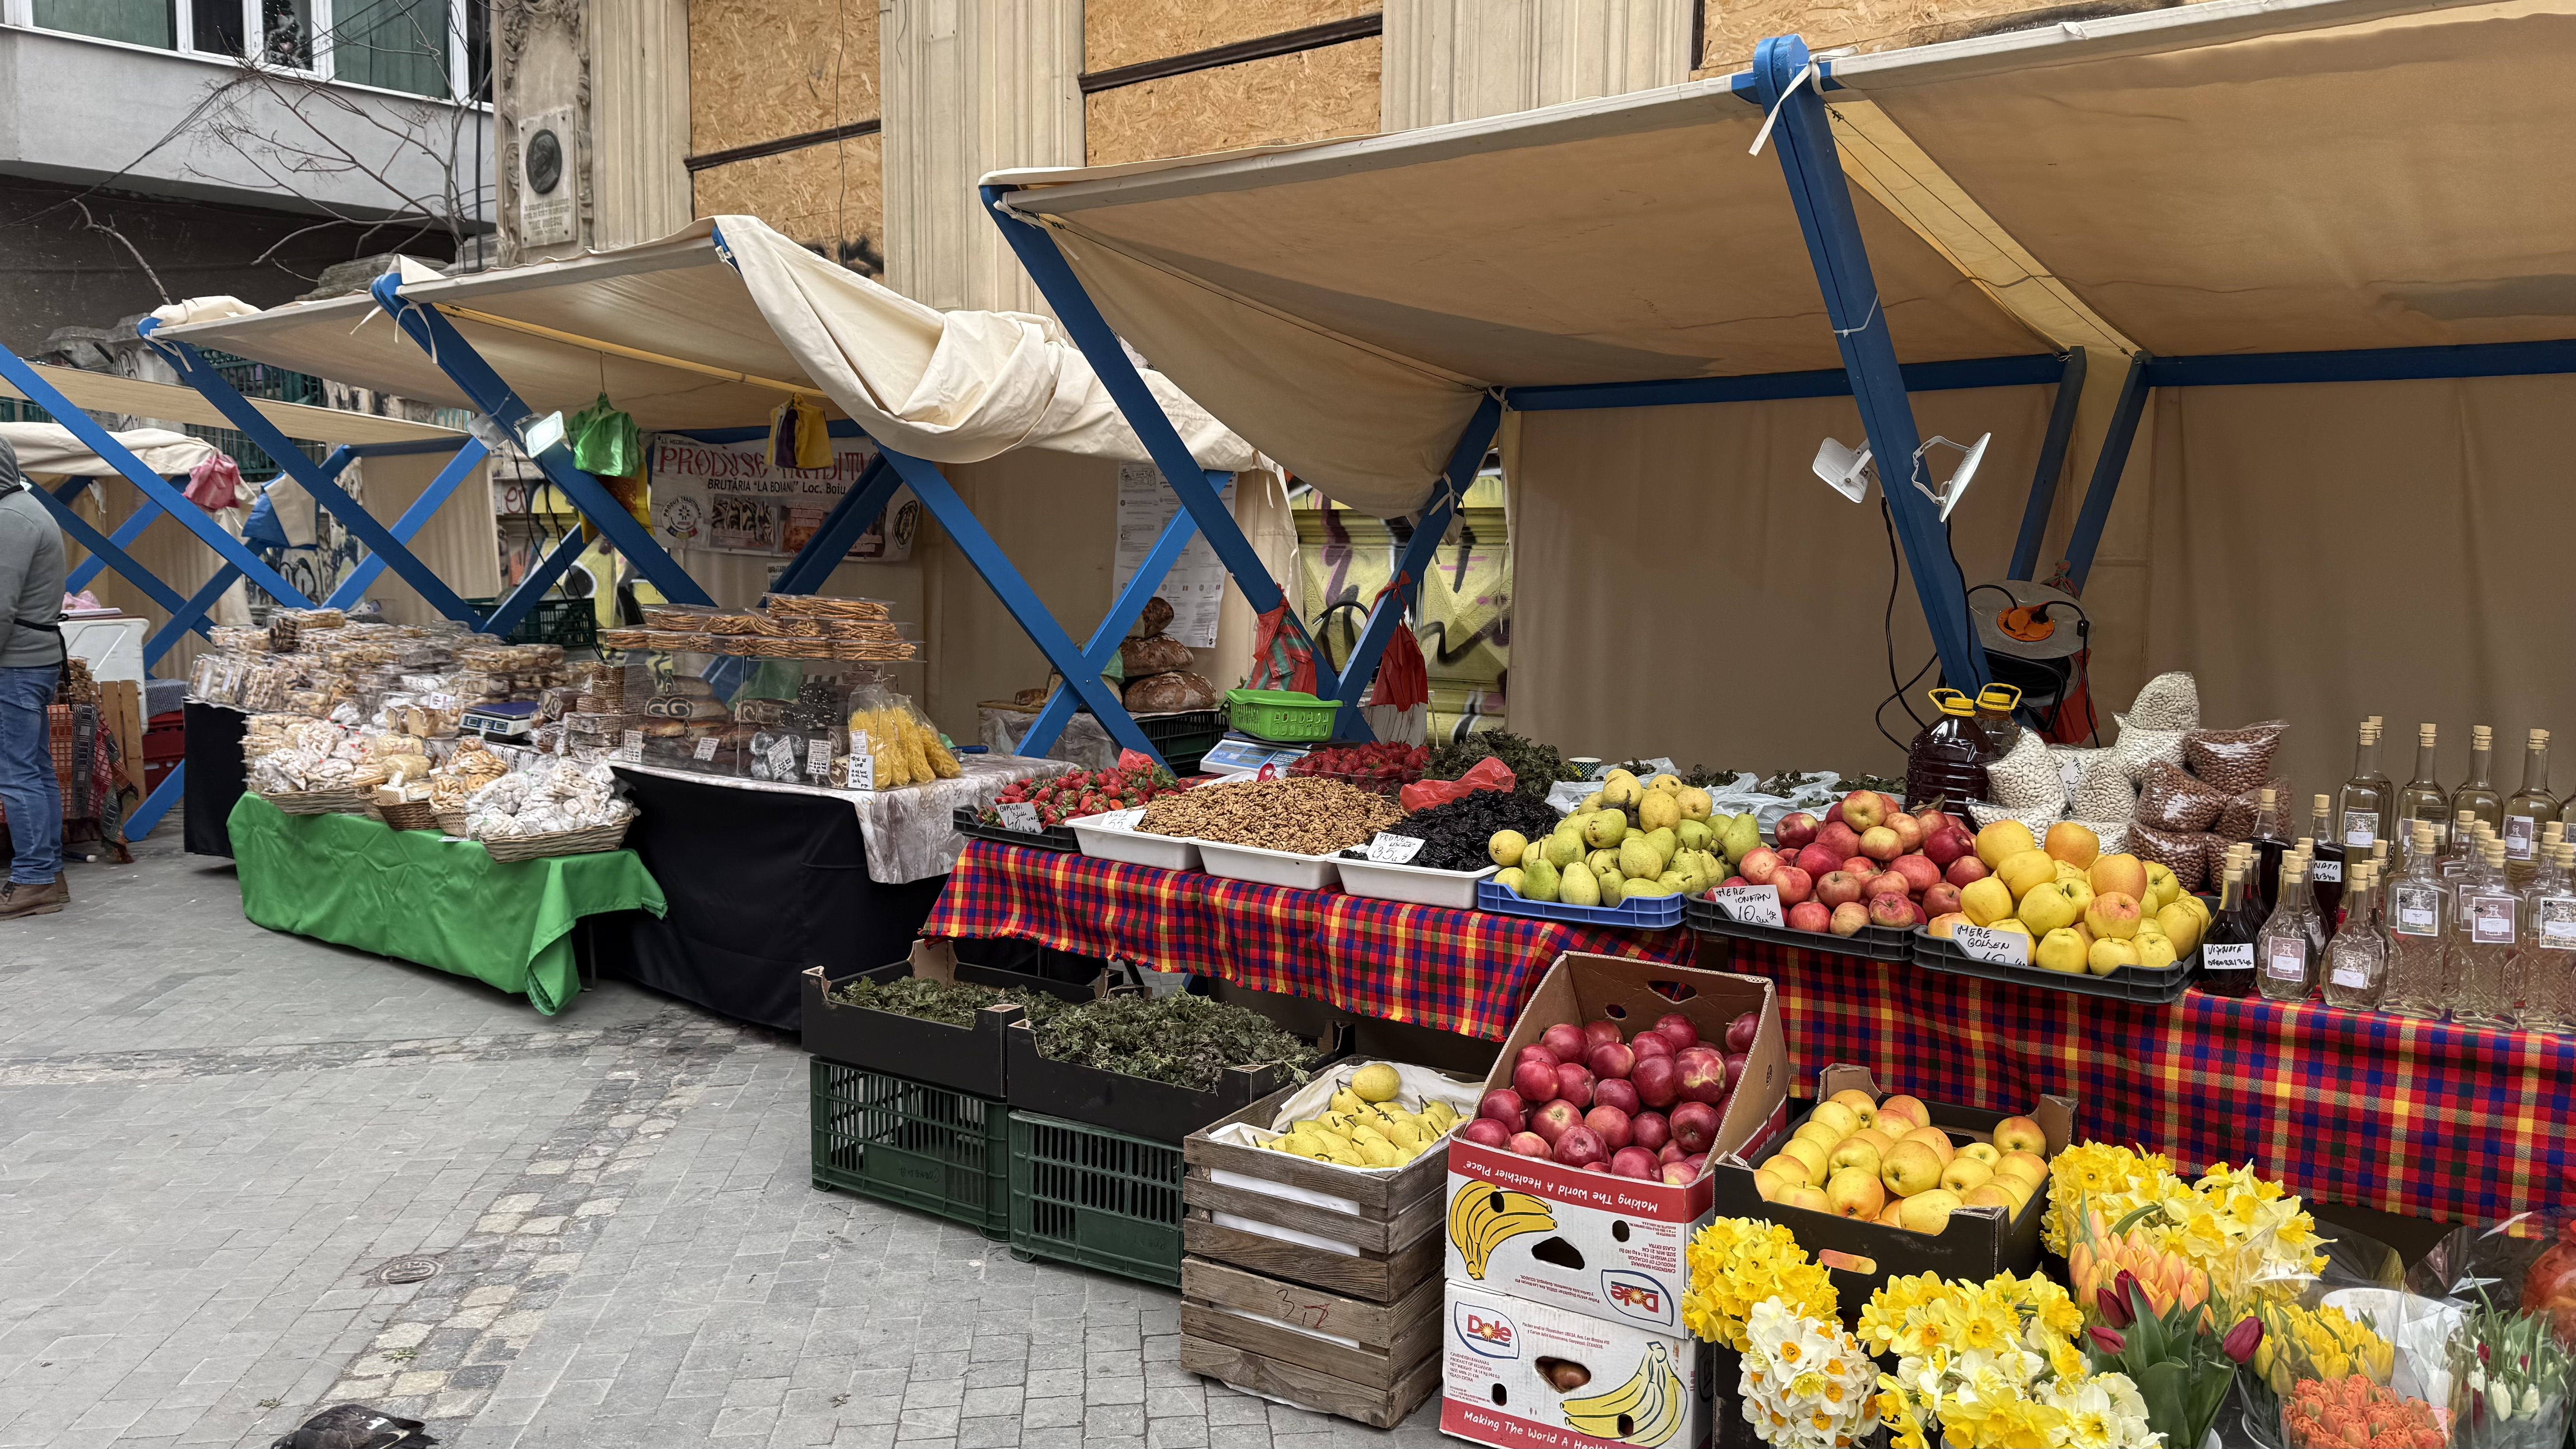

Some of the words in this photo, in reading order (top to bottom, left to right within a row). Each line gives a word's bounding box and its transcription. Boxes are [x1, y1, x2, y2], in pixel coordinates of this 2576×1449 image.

[708, 478, 751, 491] BRUTĂRIA
[803, 483, 822, 494] Loc.
[1007, 815, 1020, 831] 40
[1738, 905, 1755, 921] 10
[1958, 925, 1992, 939] MERE
[1968, 938, 2010, 949] GOLDEN
[1495, 1169, 1541, 1190] Healthier
[1546, 1182, 1554, 1192] A
[1558, 1185, 1587, 1200] World
[1592, 1192, 1612, 1205] The
[1618, 1193, 1658, 1213] Making
[1610, 1285, 1658, 1313] Dole
[1467, 1314, 1512, 1342] Dole
[1464, 1411, 1500, 1432] Making
[1504, 1421, 1523, 1435] The
[1528, 1427, 1557, 1444] World
[1561, 1437, 1569, 1447] A
